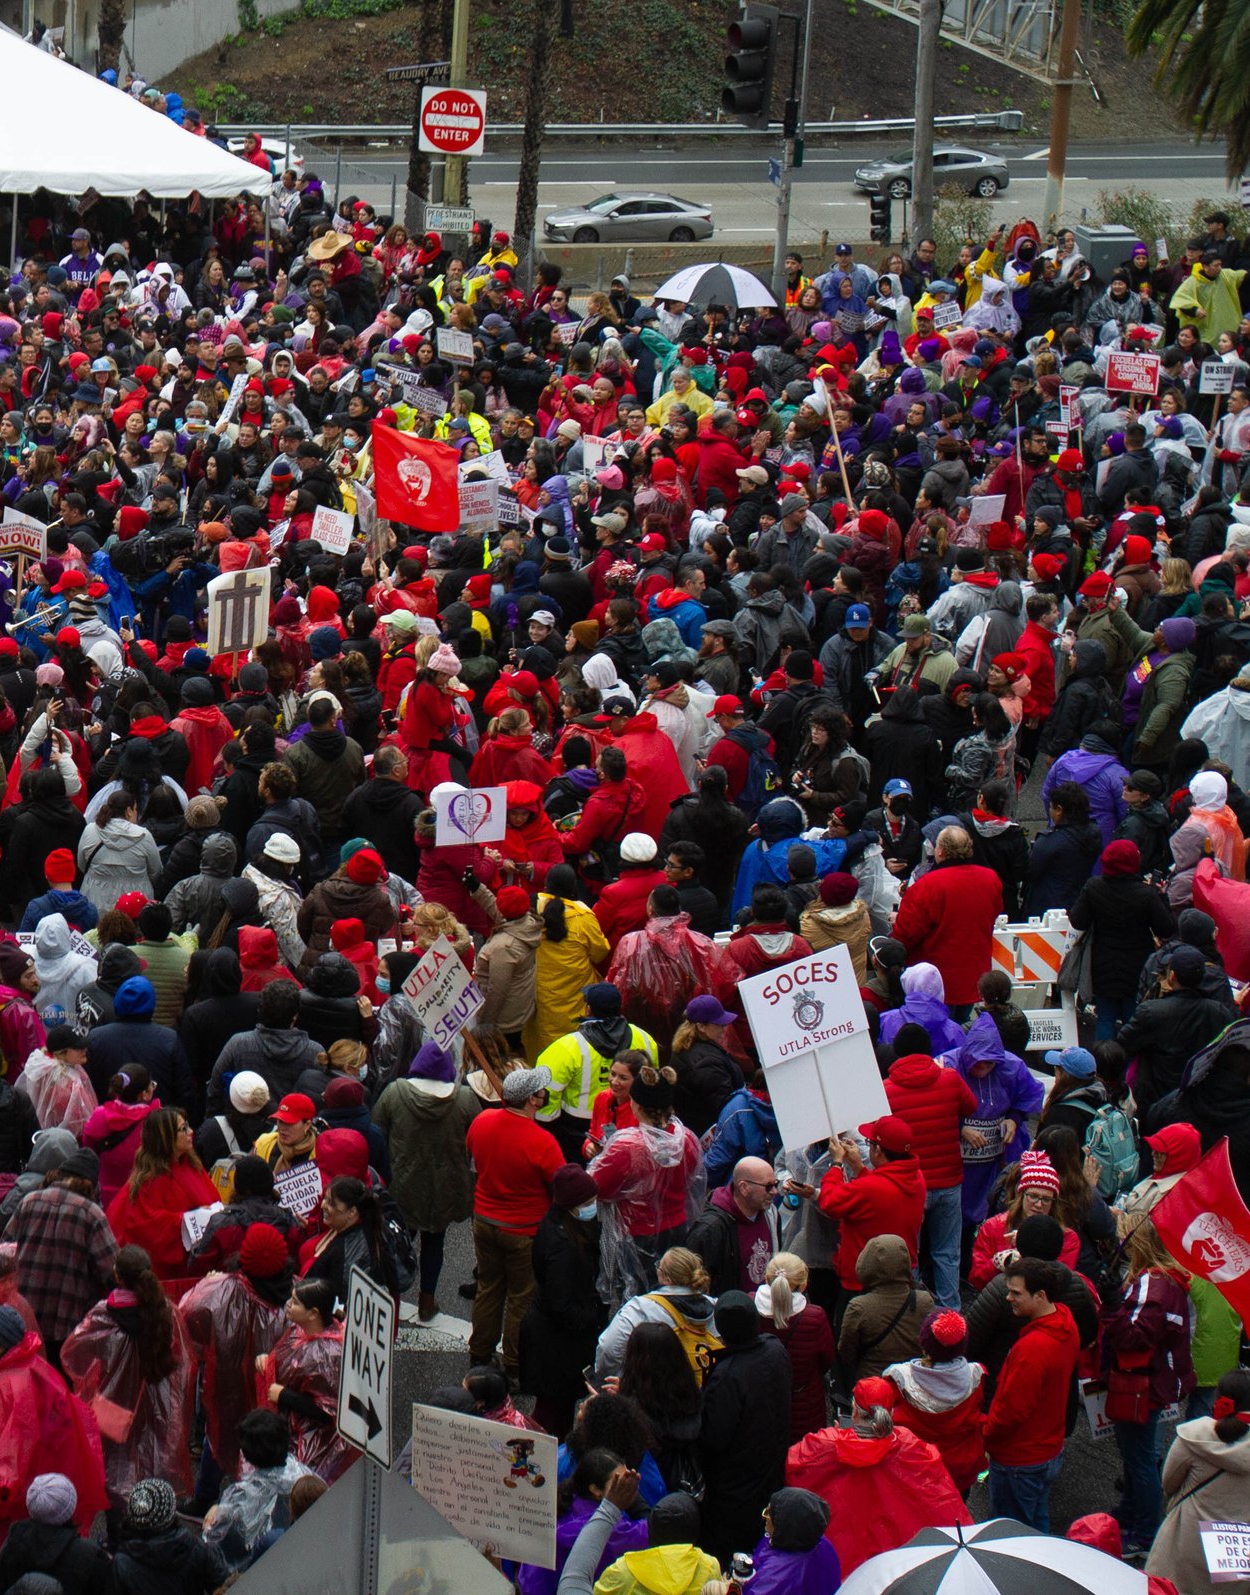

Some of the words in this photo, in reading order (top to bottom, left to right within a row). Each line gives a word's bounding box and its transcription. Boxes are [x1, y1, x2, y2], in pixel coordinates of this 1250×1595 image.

[389, 68, 429, 81] BEAUDRY
[433, 66, 449, 75] AVE
[431, 101, 447, 112] DO
[452, 102, 476, 114] NOT
[433, 128, 469, 142] ENTER
[427, 209, 473, 220] PEDESTRIANS
[429, 220, 470, 231] PROHIBITED
[1111, 356, 1143, 366] ESCUELAS
[1143, 360, 1157, 368] CON
[1114, 363, 1146, 375] PERSONAL
[1205, 366, 1215, 374] ON
[404, 950, 446, 997] UTLA
[434, 972, 441, 981] IN
[417, 962, 462, 1018] SOLIDARITY
[762, 962, 839, 1006] SOCES
[436, 985, 454, 1008] WITH
[1042, 1025, 1062, 1034] WORKS
[779, 1035, 812, 1056] UTLA
[812, 1020, 855, 1043] Strong
[287, 1170, 295, 1179] LA
[295, 1161, 316, 1175] HUELGA
[278, 1172, 319, 1195] ESCUELAS
[280, 1186, 320, 1206] CALIDAD,
[1198, 1218, 1245, 1273] TEACHERS
[353, 1287, 387, 1351] ONE
[351, 1332, 385, 1395] WAY
[449, 1420, 480, 1434] decirles
[449, 1433, 488, 1448] debemos
[413, 1438, 451, 1453] compensar
[455, 1448, 500, 1464] justamente
[423, 1451, 453, 1463] nuestro
[414, 1457, 421, 1466] El
[429, 1460, 456, 1475] Distrito
[462, 1467, 501, 1484] Unificado
[413, 1470, 423, 1478] de
[429, 1473, 444, 1483] Los
[449, 1477, 485, 1494] Angeles
[493, 1488, 512, 1497] debe
[518, 1494, 551, 1507] ayudar
[423, 1483, 451, 1496] nuestro
[456, 1491, 489, 1506] personal
[508, 1502, 553, 1518] mantenerse
[474, 1507, 510, 1519] constante
[470, 1517, 480, 1525] de
[485, 1521, 501, 1531] vida
[518, 1526, 533, 1537] los
[1217, 1535, 1239, 1546] POR
[1225, 1546, 1240, 1557] DE
